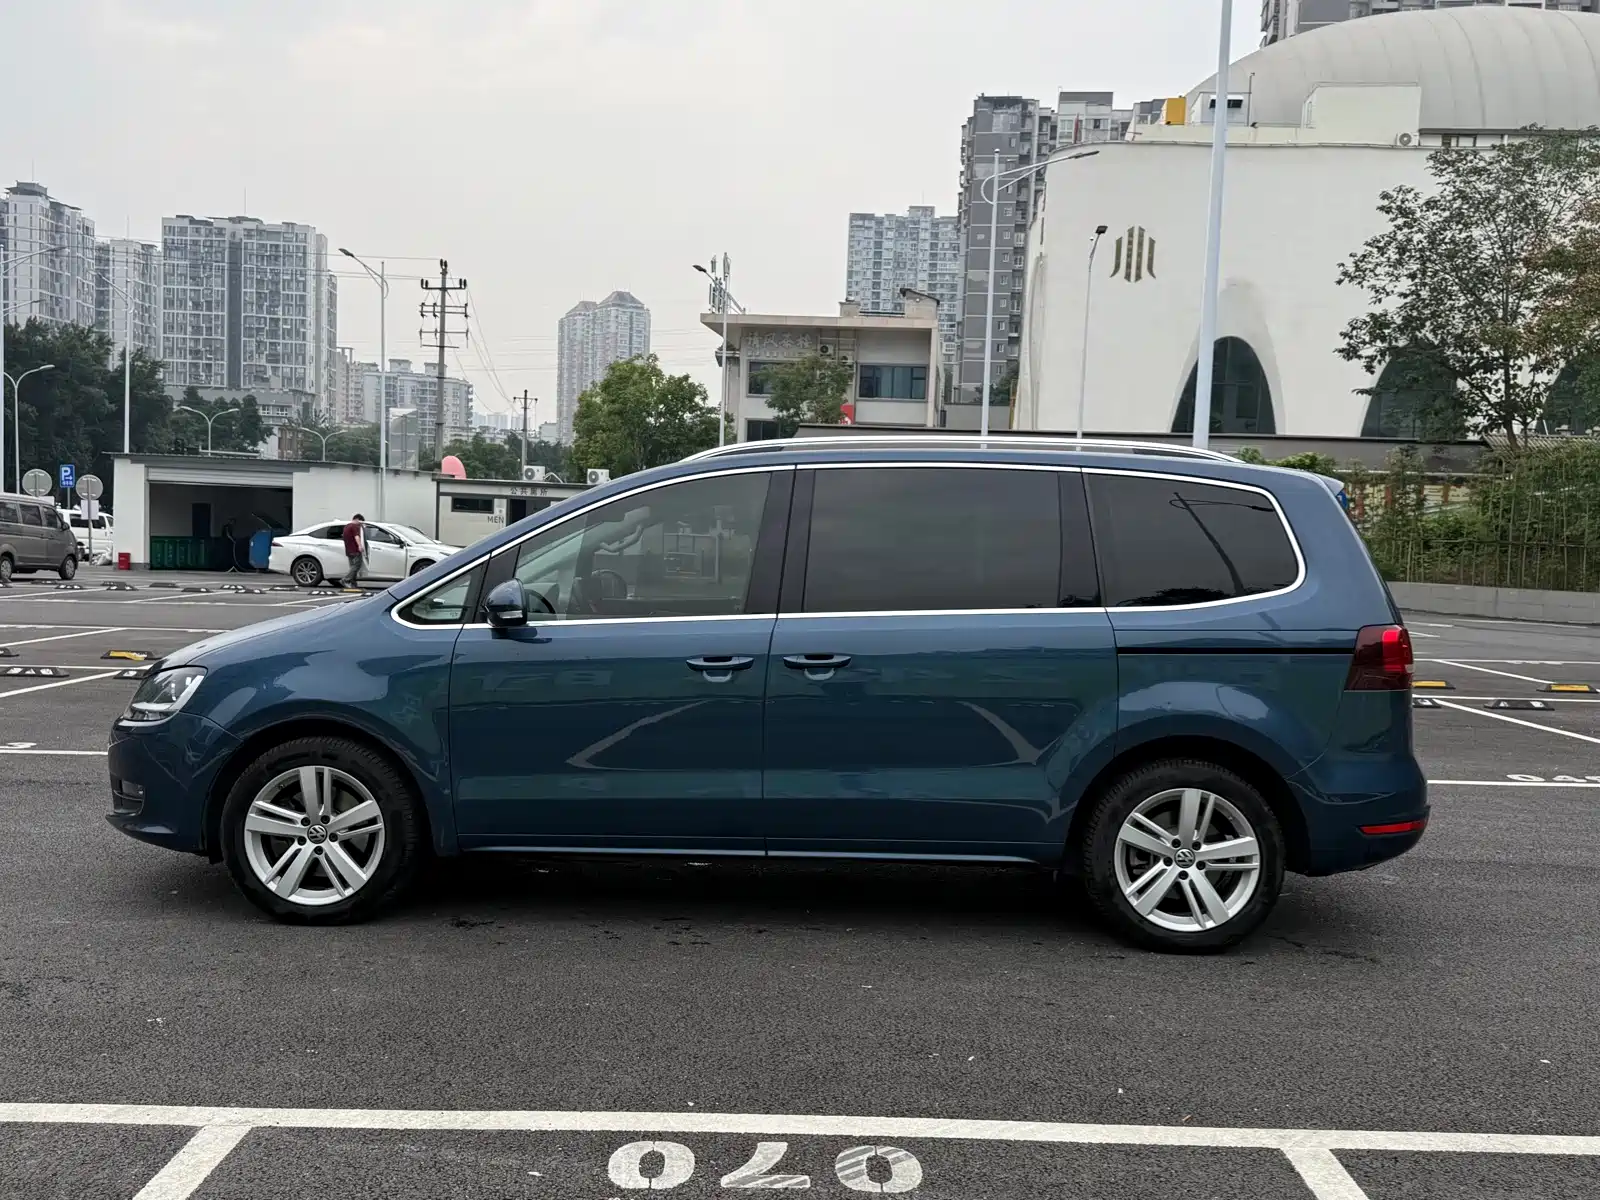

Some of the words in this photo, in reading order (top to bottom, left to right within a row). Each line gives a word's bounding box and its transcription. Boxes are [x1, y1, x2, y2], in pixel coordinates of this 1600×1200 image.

[61, 466, 71, 481] P
[510, 487, 549, 496] 公共厕所
[487, 516, 504, 524] MEN
[606, 1140, 923, 1193] 070
